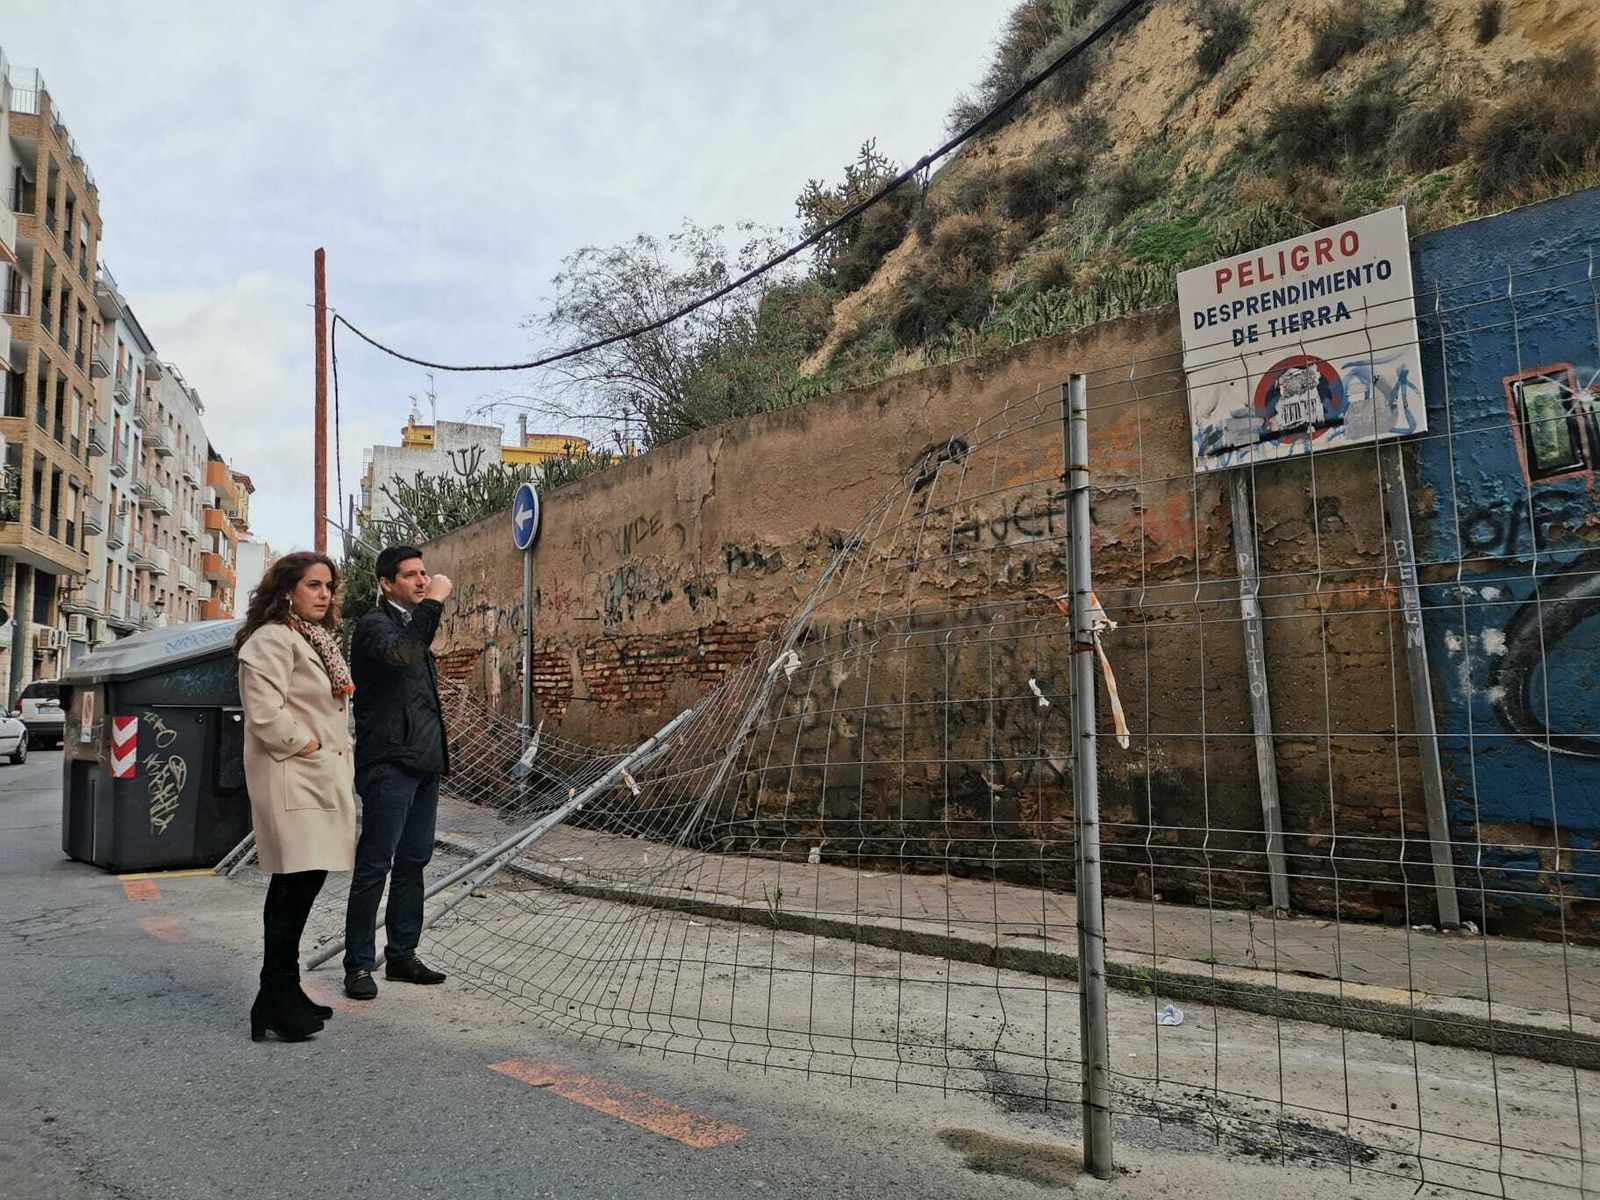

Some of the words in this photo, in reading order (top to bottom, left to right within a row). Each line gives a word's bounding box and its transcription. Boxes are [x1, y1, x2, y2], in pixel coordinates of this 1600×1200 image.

[1216, 230, 1359, 293] PELIGRO
[1194, 259, 1392, 330] DESPRENDIMIENTO
[1231, 326, 1259, 347] DE
[1268, 302, 1351, 338] TIERRA
